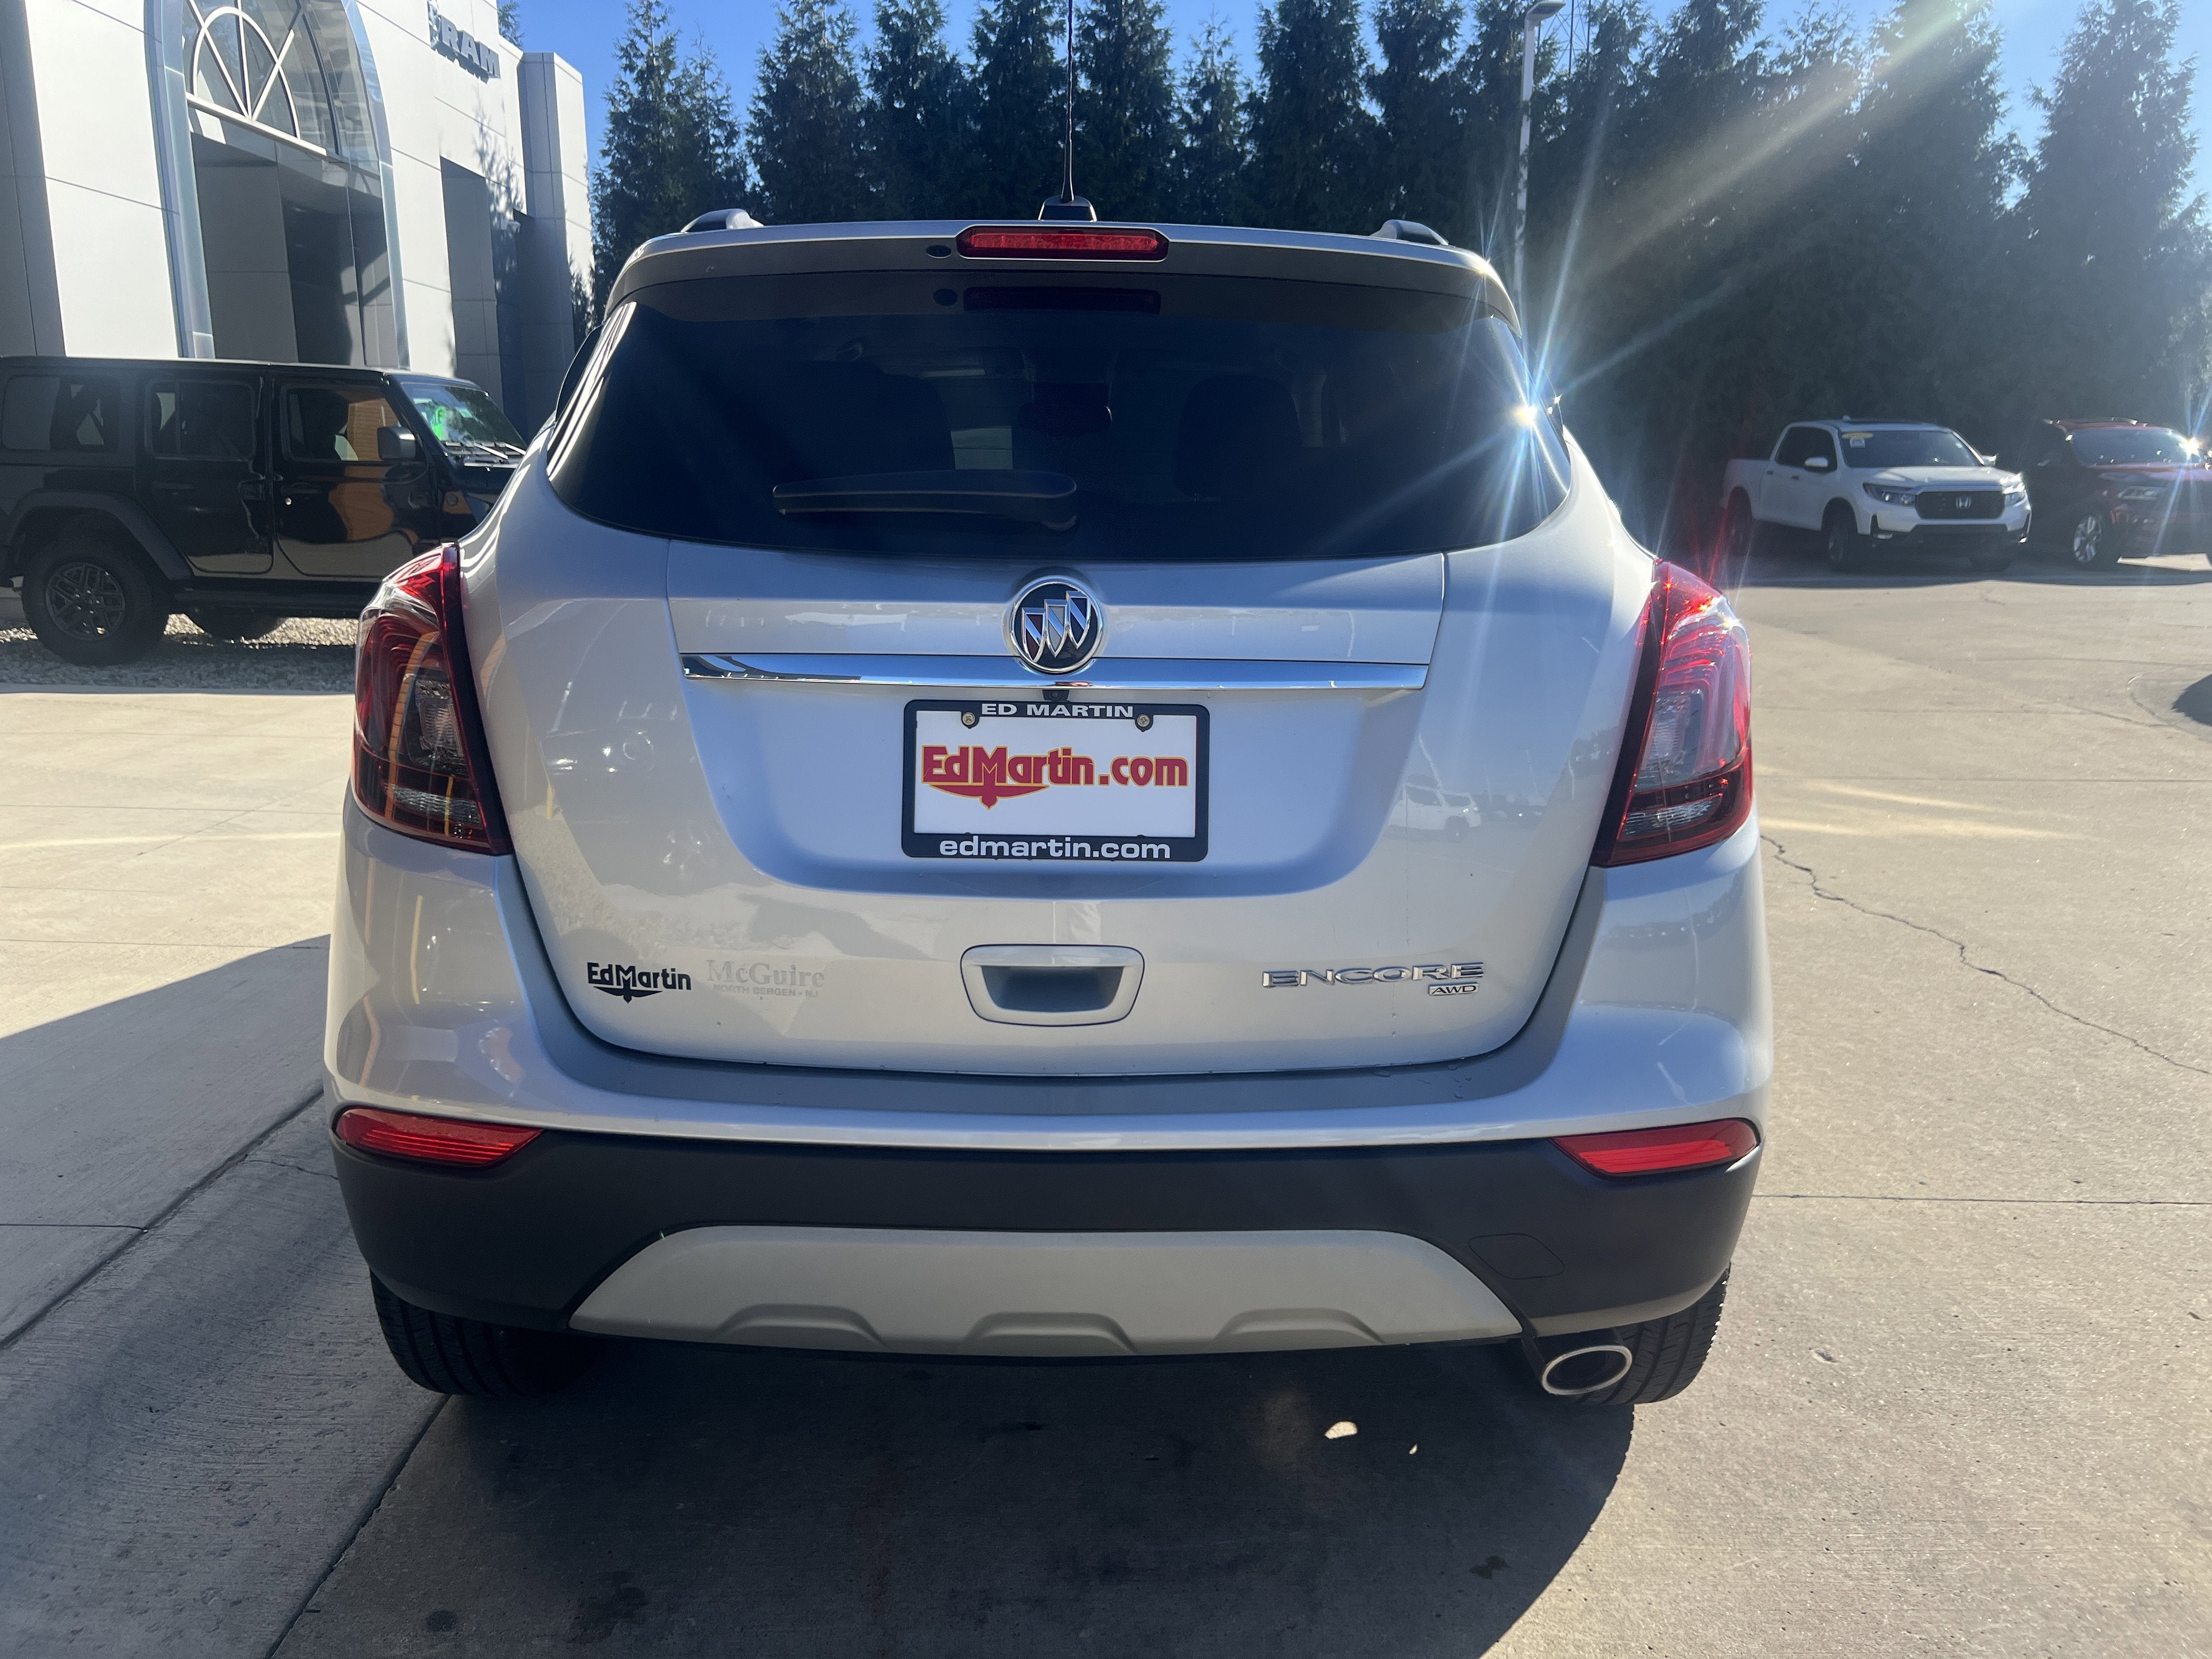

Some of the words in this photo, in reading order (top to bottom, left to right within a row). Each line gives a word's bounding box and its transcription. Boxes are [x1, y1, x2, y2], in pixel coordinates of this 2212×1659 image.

[439, 13, 501, 79] RAM
[981, 703, 1018, 716] ED
[1026, 704, 1133, 718] MARTIN
[921, 745, 1189, 789] EdMartin.com
[939, 836, 1171, 859] edmartin.com
[586, 962, 692, 991] EdMartin
[706, 959, 825, 988] McGuire
[1262, 962, 1485, 988] ENCORE
[713, 984, 749, 994] NORTH
[752, 986, 796, 997] BERGEN
[1430, 984, 1478, 996] AWD
